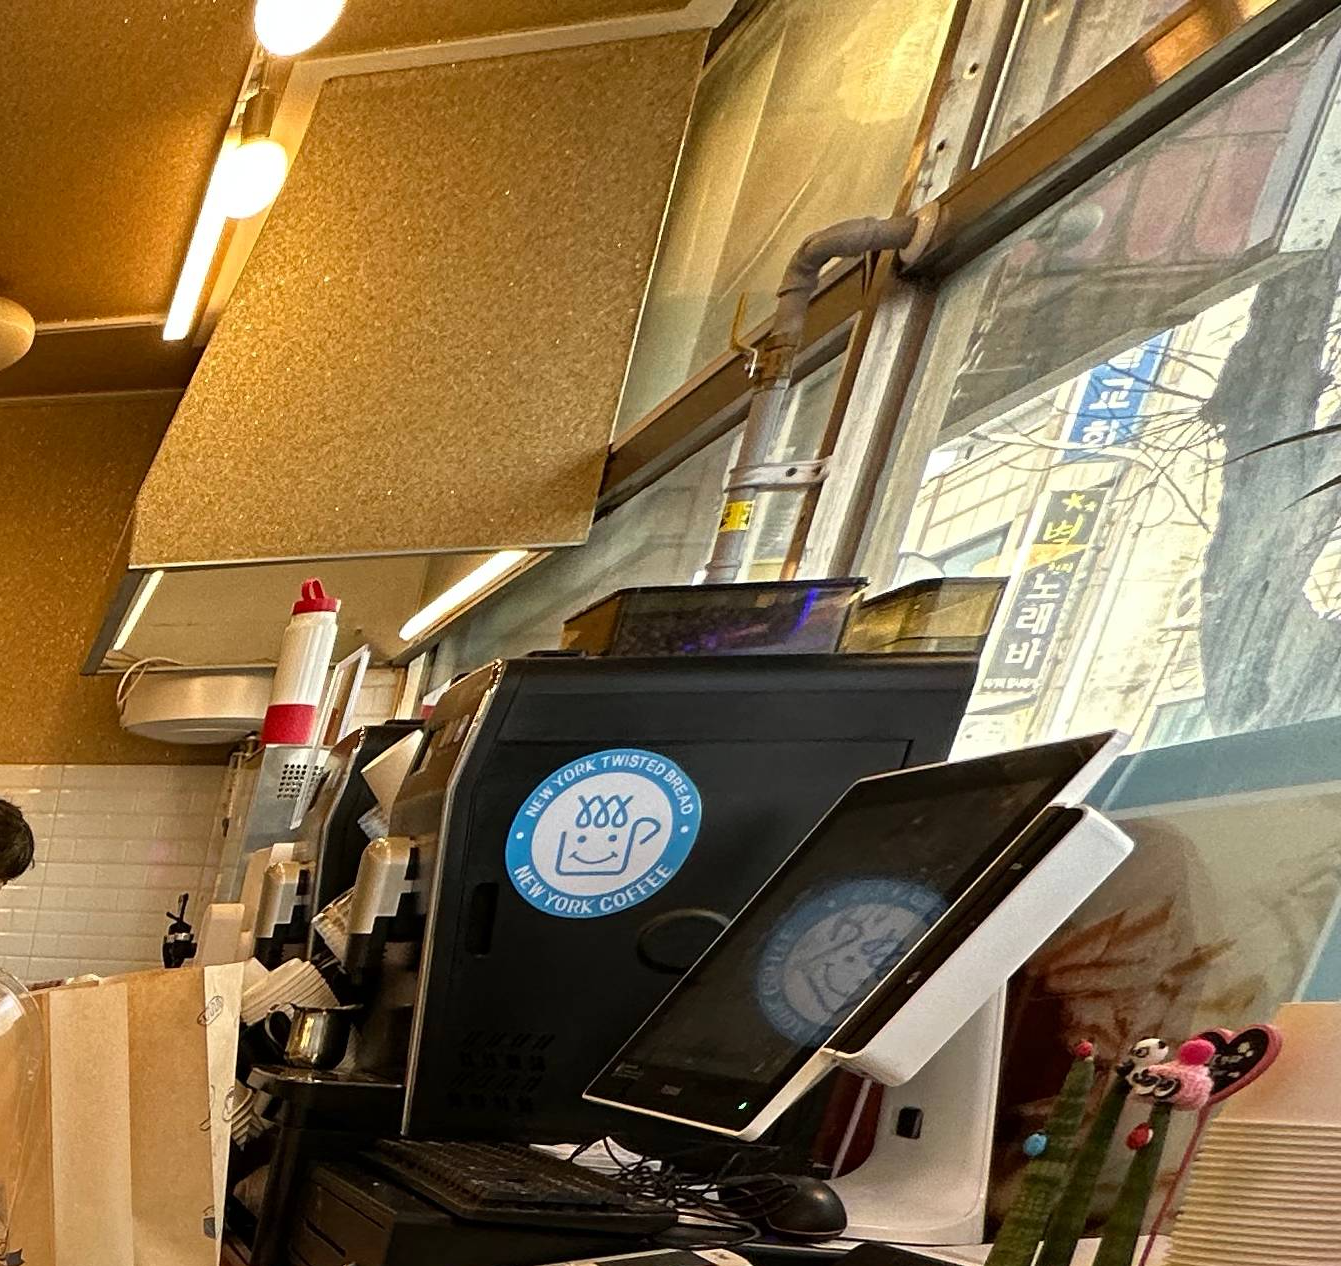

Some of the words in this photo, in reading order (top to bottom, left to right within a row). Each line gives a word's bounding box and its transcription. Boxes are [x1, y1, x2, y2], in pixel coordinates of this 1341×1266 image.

[1005, 573, 1061, 671] 노래바
[525, 786, 554, 818] NEW
[552, 759, 597, 787] YORK
[601, 755, 667, 776] TWISTED
[664, 769, 693, 815] BREAD
[514, 864, 545, 898] NEW
[545, 891, 594, 914] YORK
[599, 863, 673, 912] COFFEE
